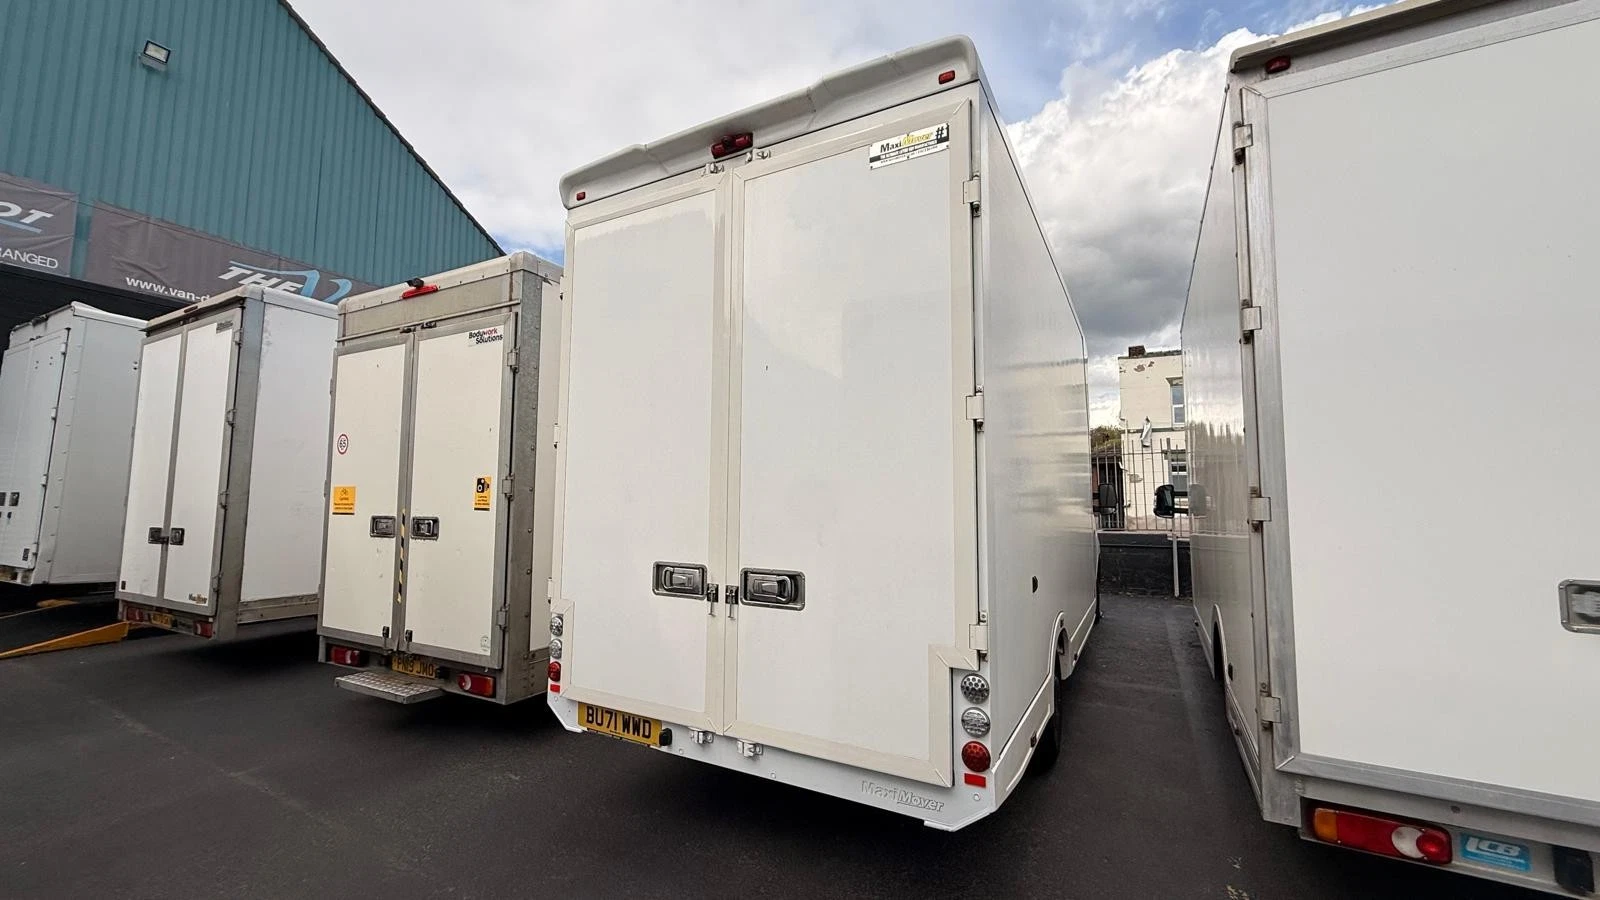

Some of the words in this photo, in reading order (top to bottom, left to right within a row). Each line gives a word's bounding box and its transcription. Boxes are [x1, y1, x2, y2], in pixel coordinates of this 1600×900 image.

[0, 247, 59, 269] ANGED
[468, 328, 498, 339] Bodywork
[475, 334, 503, 344] Solutions
[586, 705, 618, 731] BU71
[621, 713, 652, 739] WWD
